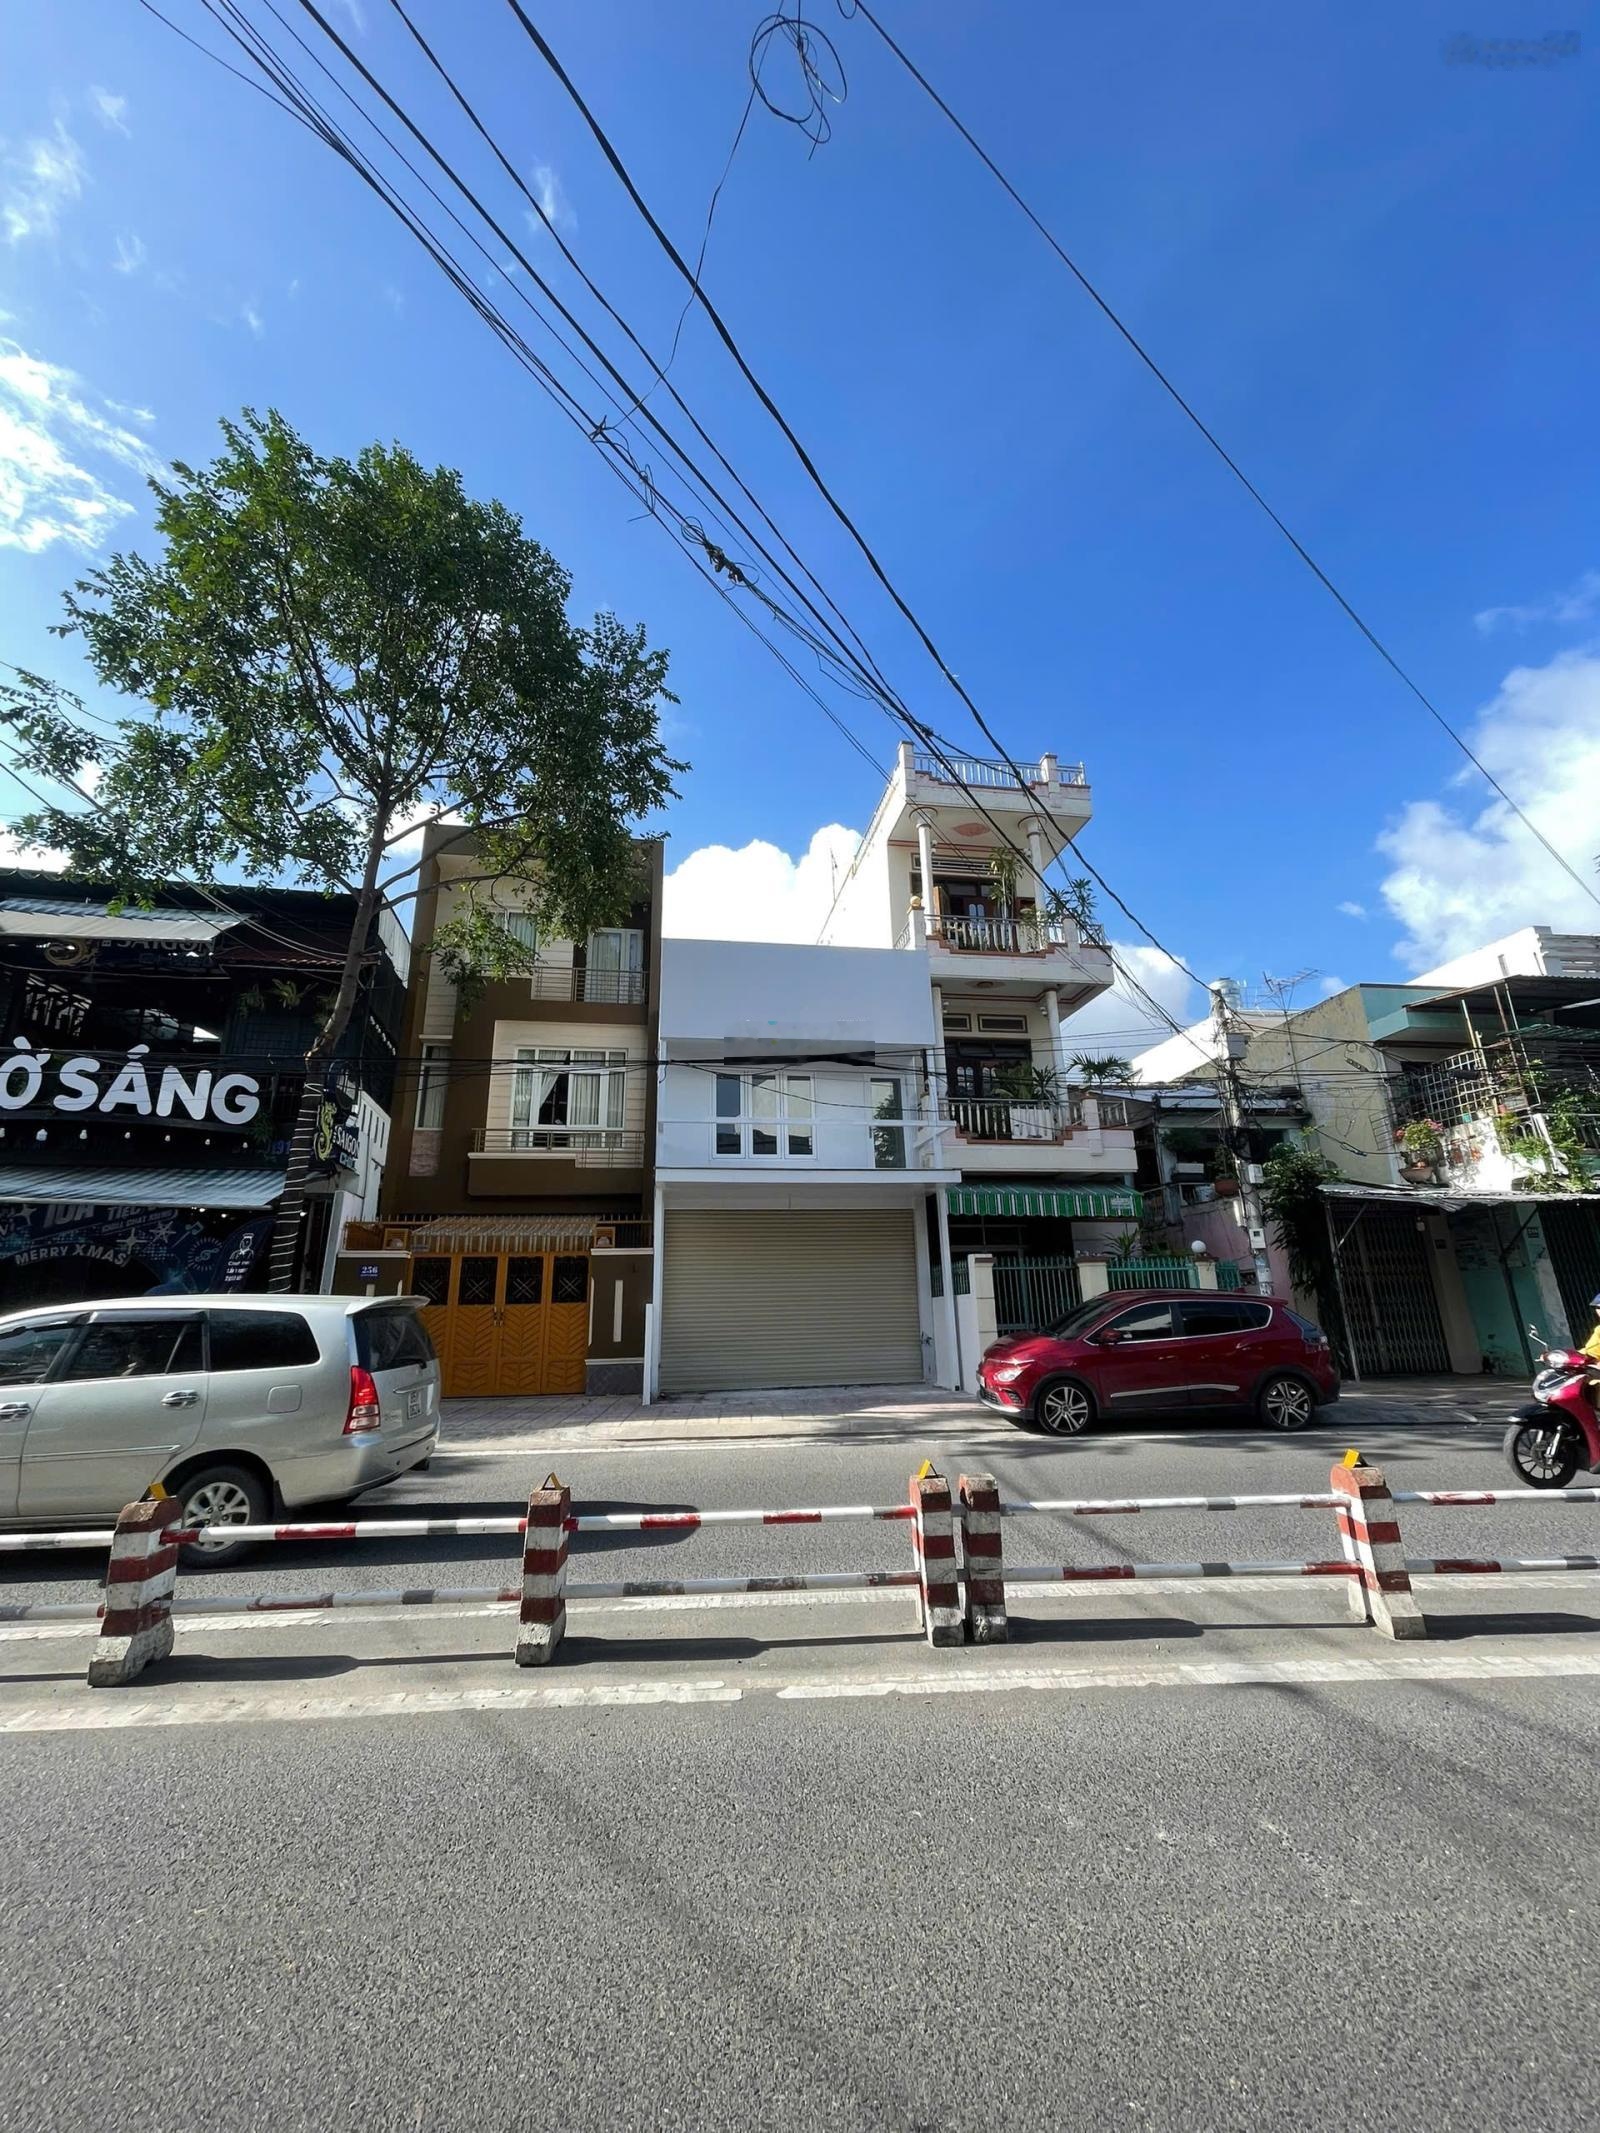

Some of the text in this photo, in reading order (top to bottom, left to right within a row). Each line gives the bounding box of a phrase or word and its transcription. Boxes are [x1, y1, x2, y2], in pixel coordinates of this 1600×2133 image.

[53, 1043, 260, 1126] SÁNG
[14, 1243, 127, 1266] MERRY XMAS
